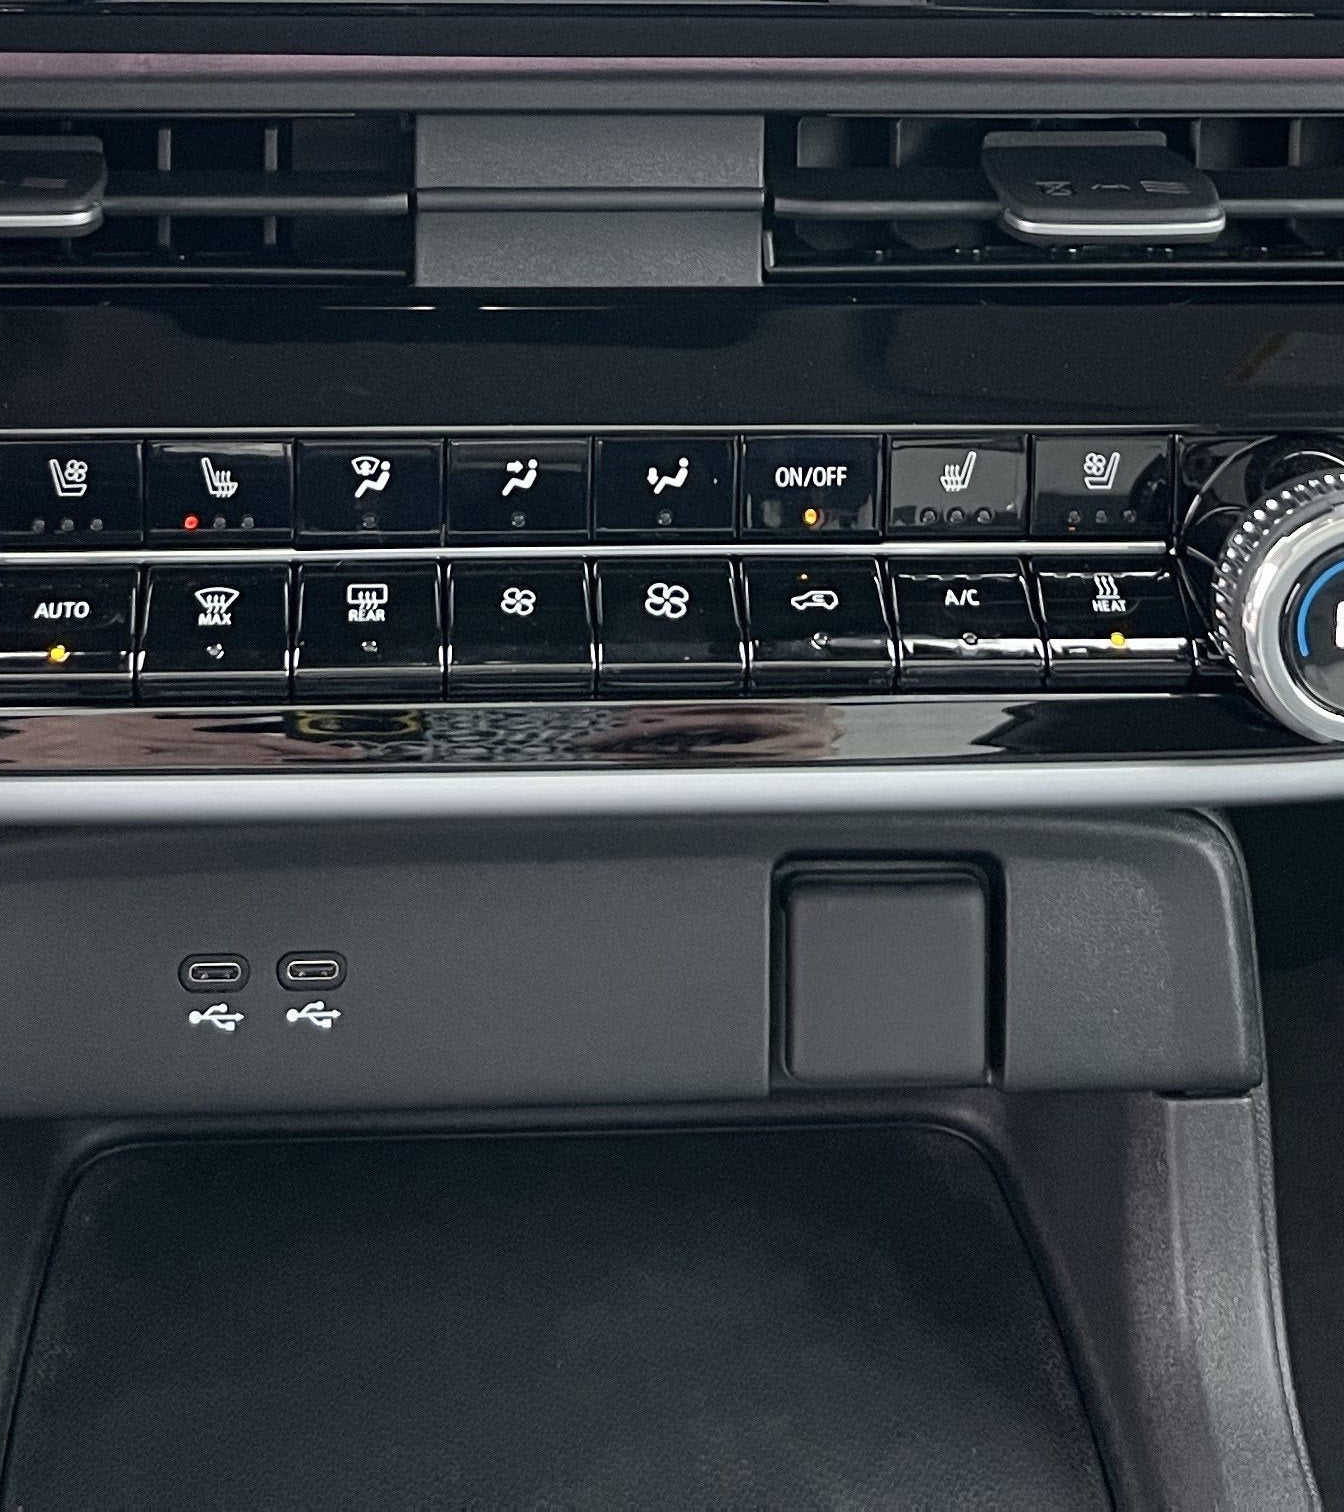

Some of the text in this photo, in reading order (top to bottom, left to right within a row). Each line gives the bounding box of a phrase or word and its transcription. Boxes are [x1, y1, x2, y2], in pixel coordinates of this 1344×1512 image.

[774, 466, 848, 488] ON/OFF
[944, 588, 980, 607] A/C
[1091, 596, 1127, 613] HEAT
[33, 601, 90, 619] AUTO
[197, 611, 232, 626] MAX
[347, 604, 386, 623] REAR
